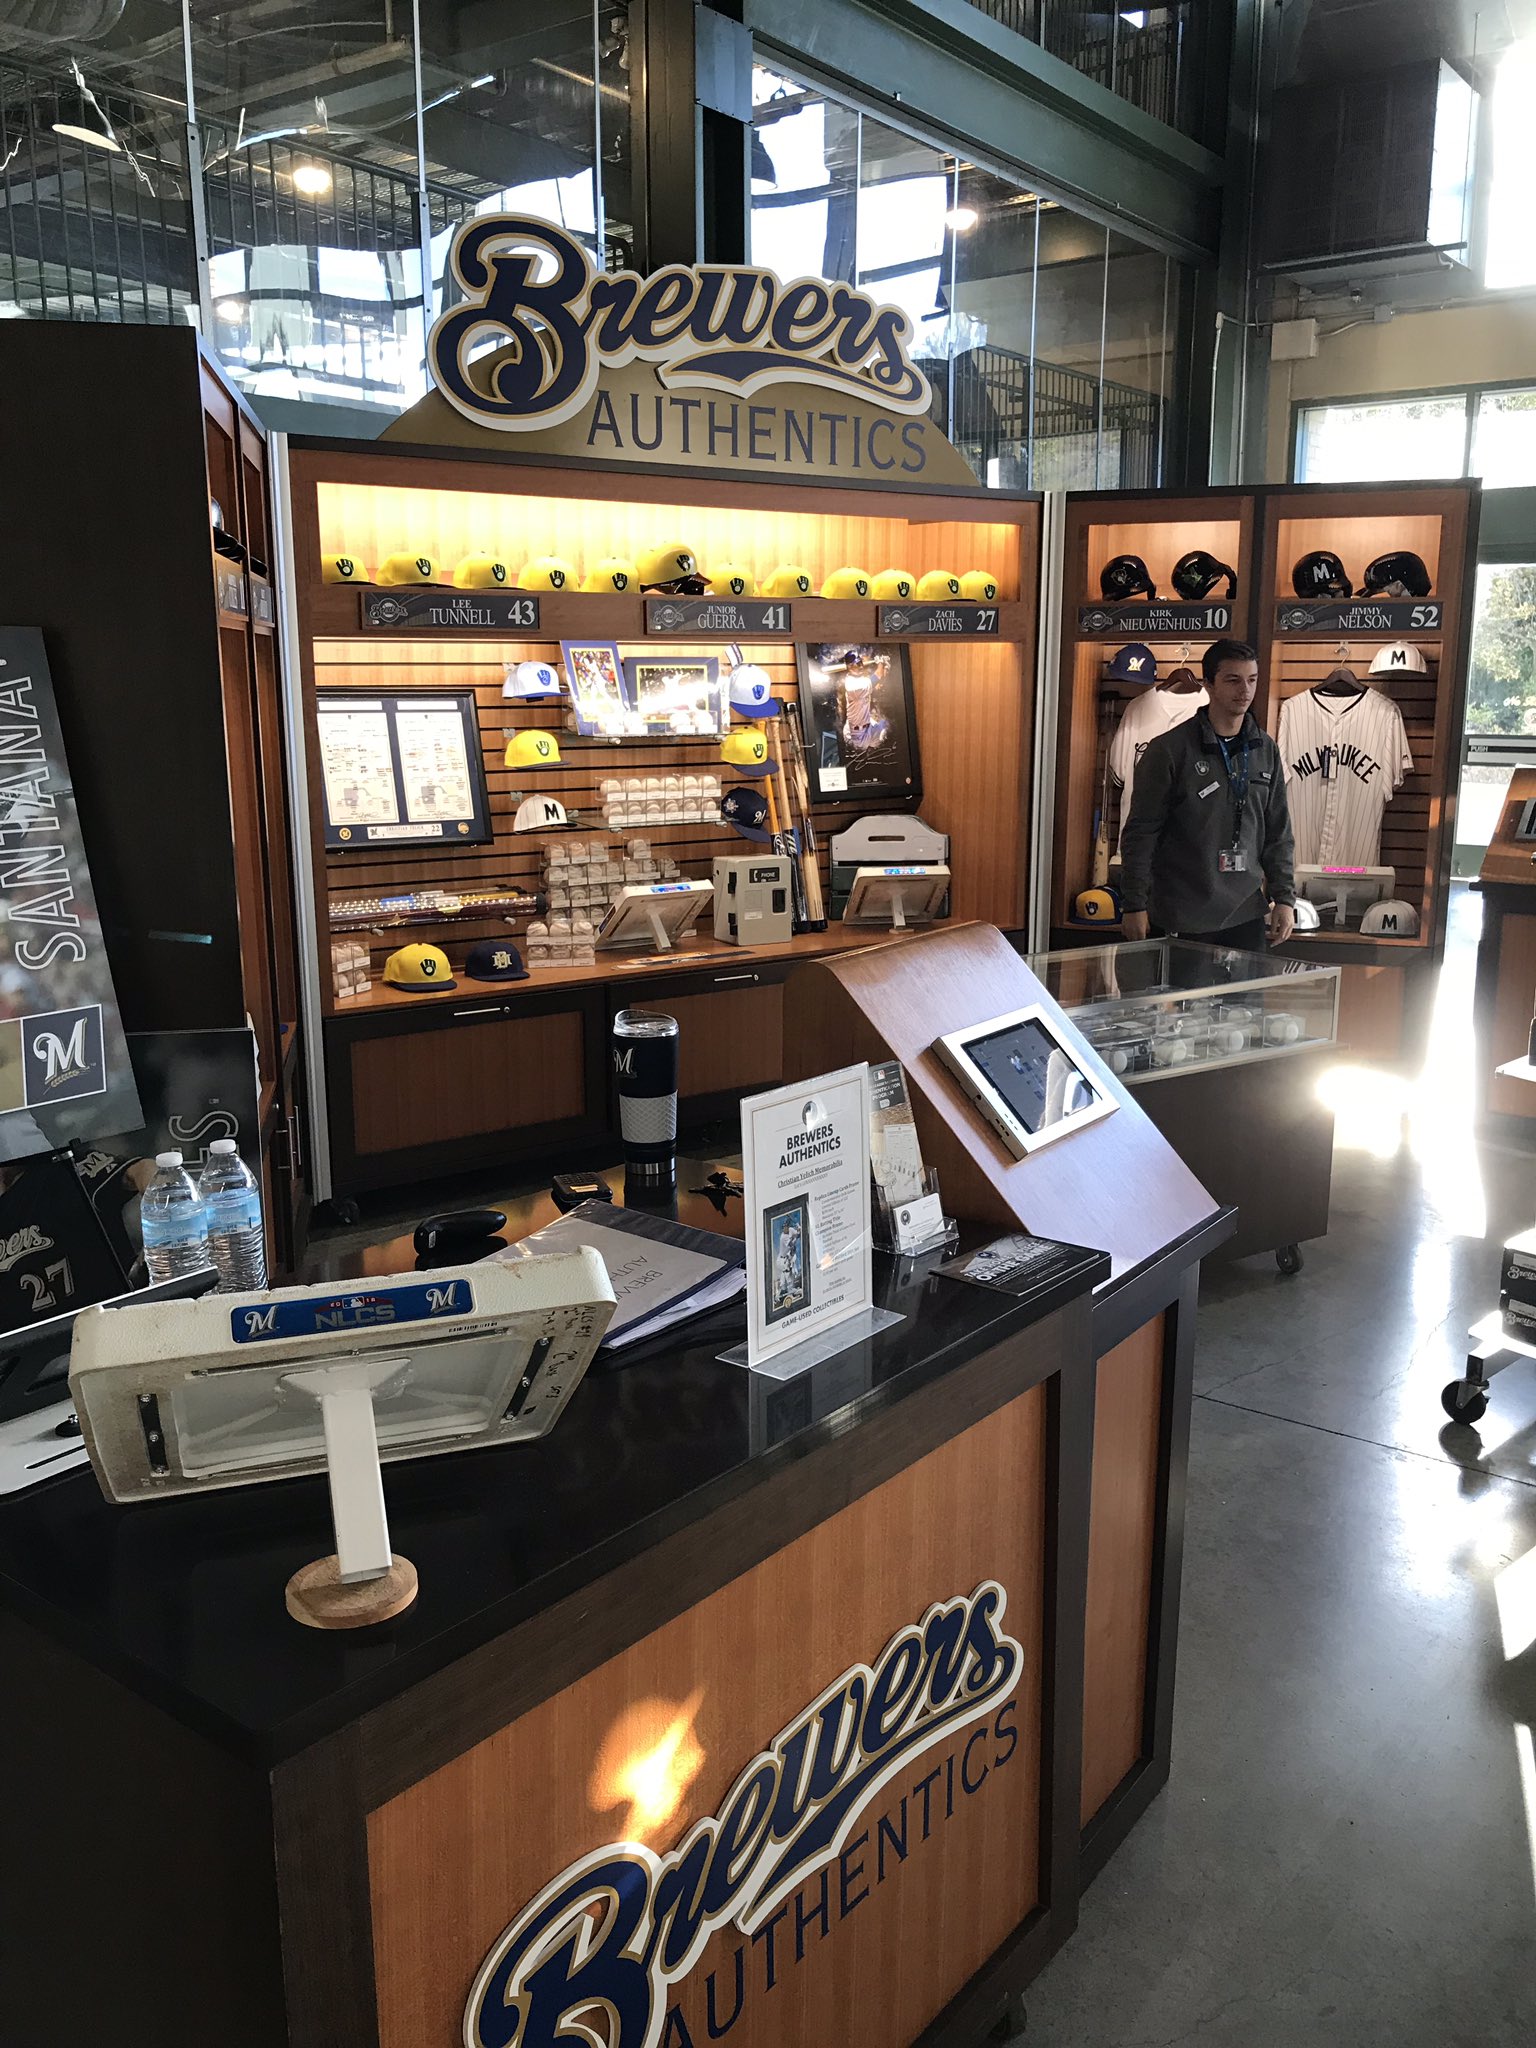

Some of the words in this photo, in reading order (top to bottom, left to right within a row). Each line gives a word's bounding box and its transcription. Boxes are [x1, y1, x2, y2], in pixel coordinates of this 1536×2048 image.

[431, 214, 931, 424] Brewers
[587, 390, 927, 473] AUTHENTICS
[1312, 563, 1330, 583] M
[429, 607, 496, 626] TUNNELL
[507, 600, 536, 625] 43
[452, 599, 472, 609] LEE
[706, 605, 737, 615] JUNIOR
[935, 610, 955, 618] ZACH
[1149, 609, 1173, 618] KIRK
[1349, 607, 1383, 616] JIMMY
[697, 613, 746, 631] GUERRA
[761, 607, 787, 631] 41
[928, 617, 963, 632] DAVIES
[976, 610, 996, 631] 27
[1119, 616, 1201, 632] NIEUWENHUIS
[1203, 608, 1228, 629] 10
[1337, 614, 1393, 630] NELSON
[1410, 607, 1439, 629] 52
[1390, 650, 1407, 665] M
[0, 677, 87, 970] SANTANA
[543, 803, 560, 821] M
[1381, 914, 1398, 930] M
[786, 1123, 834, 1151] BREWERS
[779, 1136, 841, 1169] AUTHENTICS
[976, 1270, 998, 1282] OF
[994, 1258, 1020, 1276] THE
[20, 1256, 75, 1312] 27
[315, 1304, 396, 1330] NLCS
[781, 1310, 812, 1330] GAME-USED
[812, 1294, 845, 1315] COLLECTIBLES
[465, 1581, 1023, 2048] Brewers
[664, 1700, 1018, 2048] AUTHENTICS
